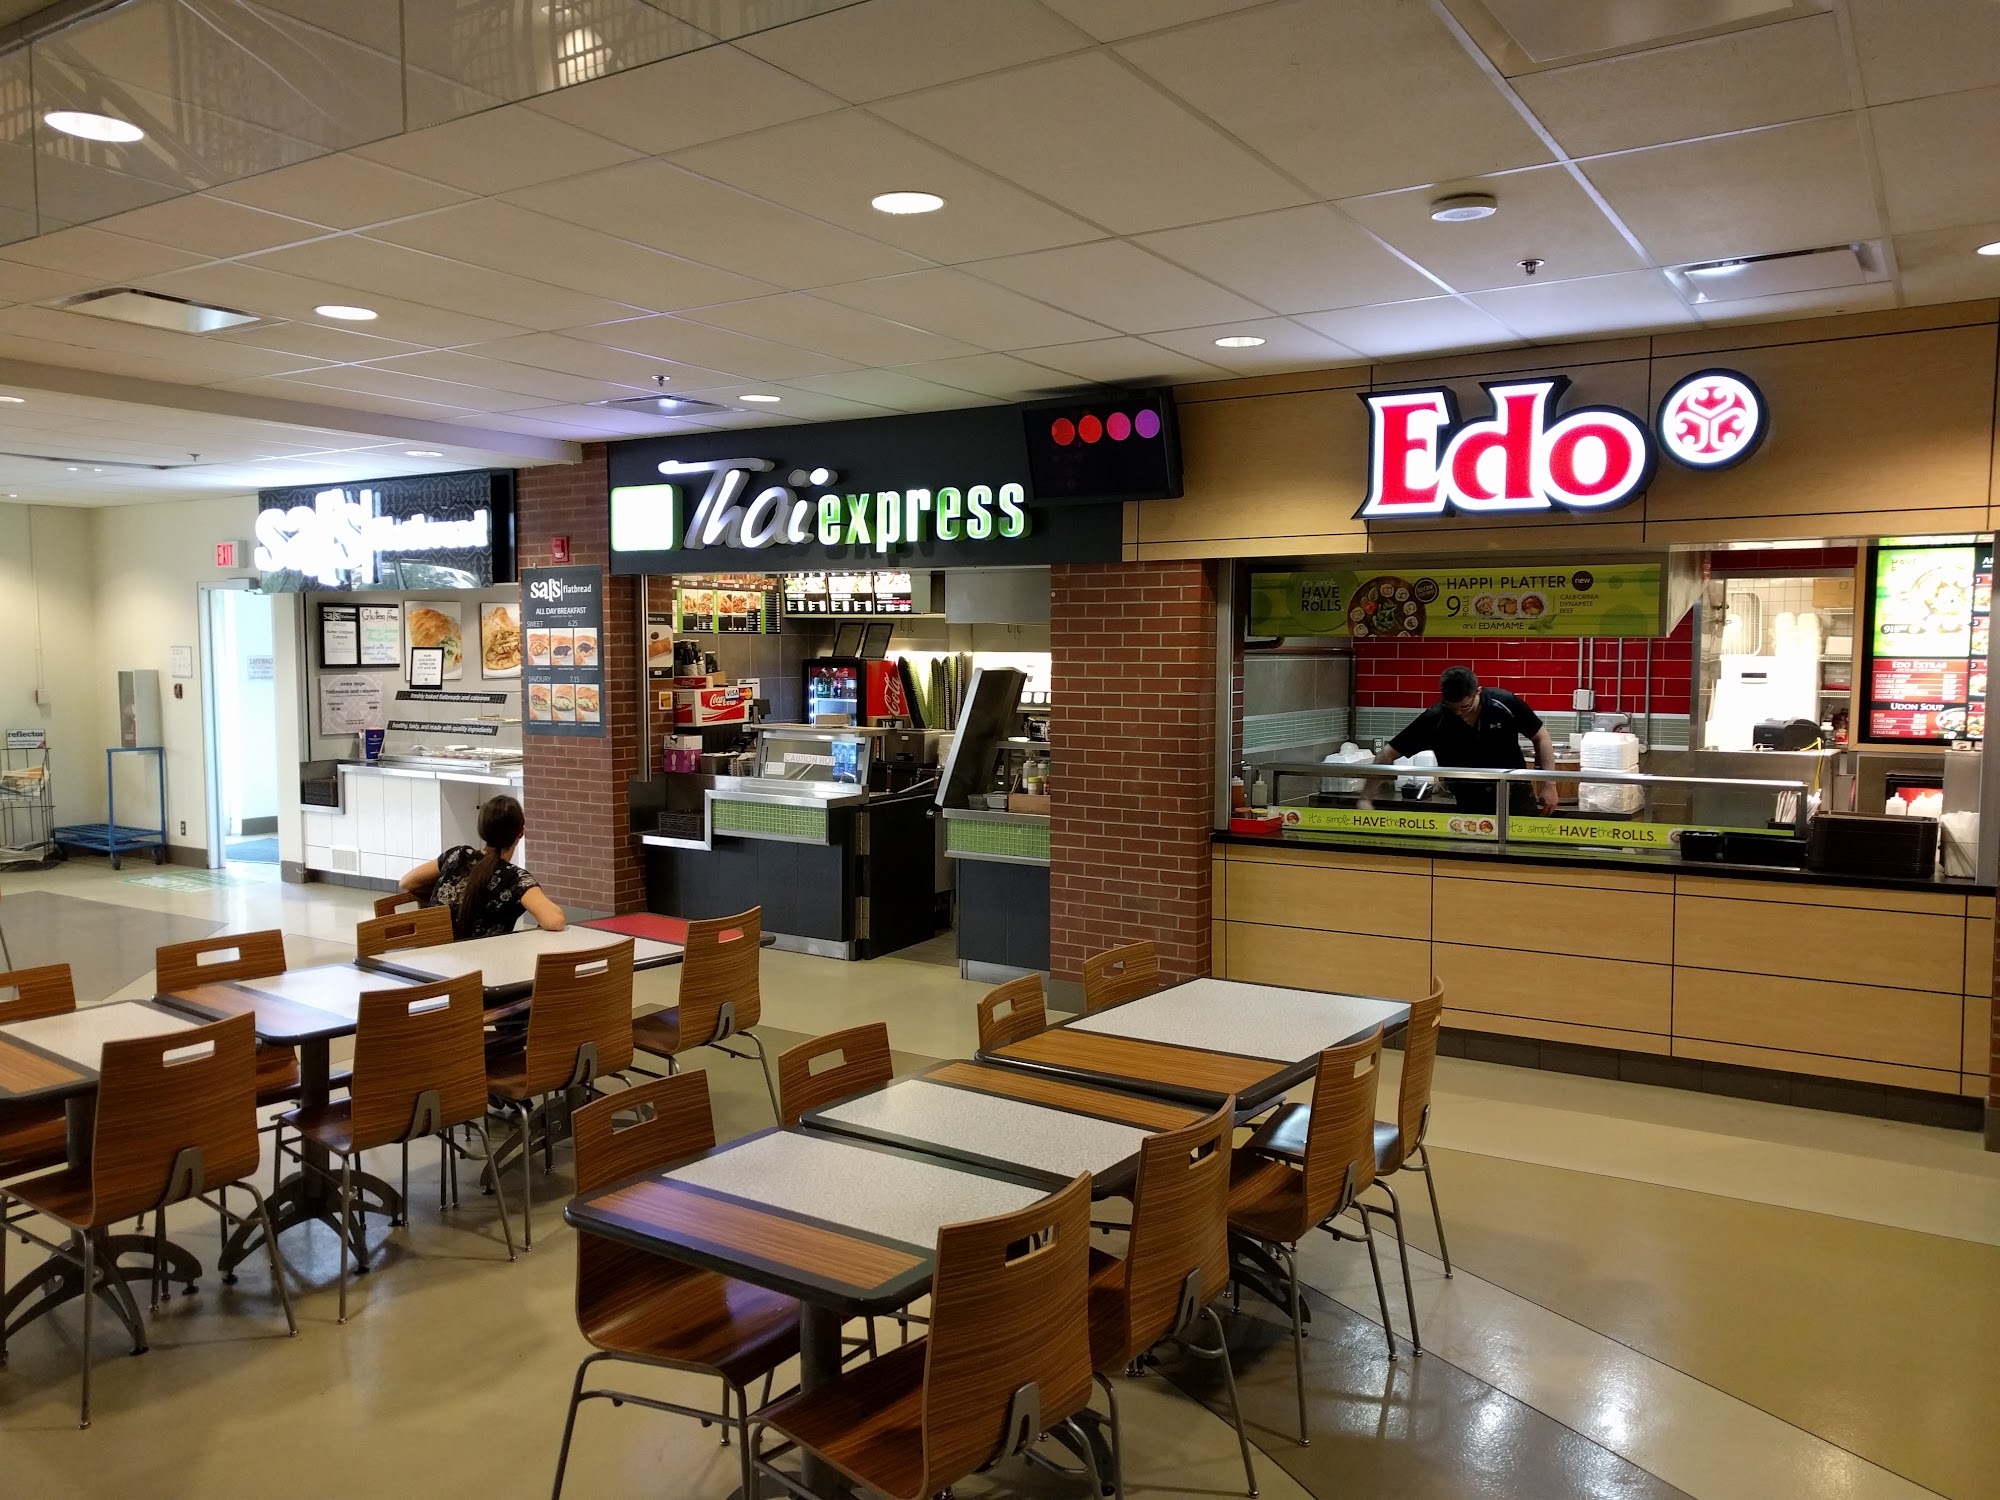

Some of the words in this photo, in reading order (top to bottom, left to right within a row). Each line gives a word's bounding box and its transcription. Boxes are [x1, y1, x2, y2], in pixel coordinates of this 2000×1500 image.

[1367, 385, 1641, 511] Edo
[816, 482, 1026, 553] express
[216, 544, 233, 566] EXIT
[1447, 577, 1493, 589] HAPPI
[1500, 575, 1566, 589] PLATTER
[562, 584, 591, 594] flatbread
[1301, 587, 1339, 599] HAVE
[545, 607, 557, 615] DAY
[557, 606, 587, 614] BREAKFAST
[1446, 595, 1461, 617] 9
[362, 609, 385, 621] Gluten
[387, 609, 398, 621] Free
[526, 620, 543, 628] SWEET
[1462, 622, 1477, 630] and
[1478, 622, 1524, 630] EDAMAME
[1892, 661, 1911, 669] EDO
[1913, 661, 1947, 669] EXTRAS
[528, 675, 552, 683] SAVOURY
[1890, 702, 1919, 710] UDON
[1920, 703, 1945, 711] SOUP
[784, 753, 818, 764] CAUTION
[820, 756, 835, 764] HOT
[1308, 813, 1322, 824] it's
[1353, 815, 1386, 828] HAVE
[1386, 815, 1400, 827] the
[1559, 825, 1598, 838] HAVE
[1597, 826, 1613, 838] the
